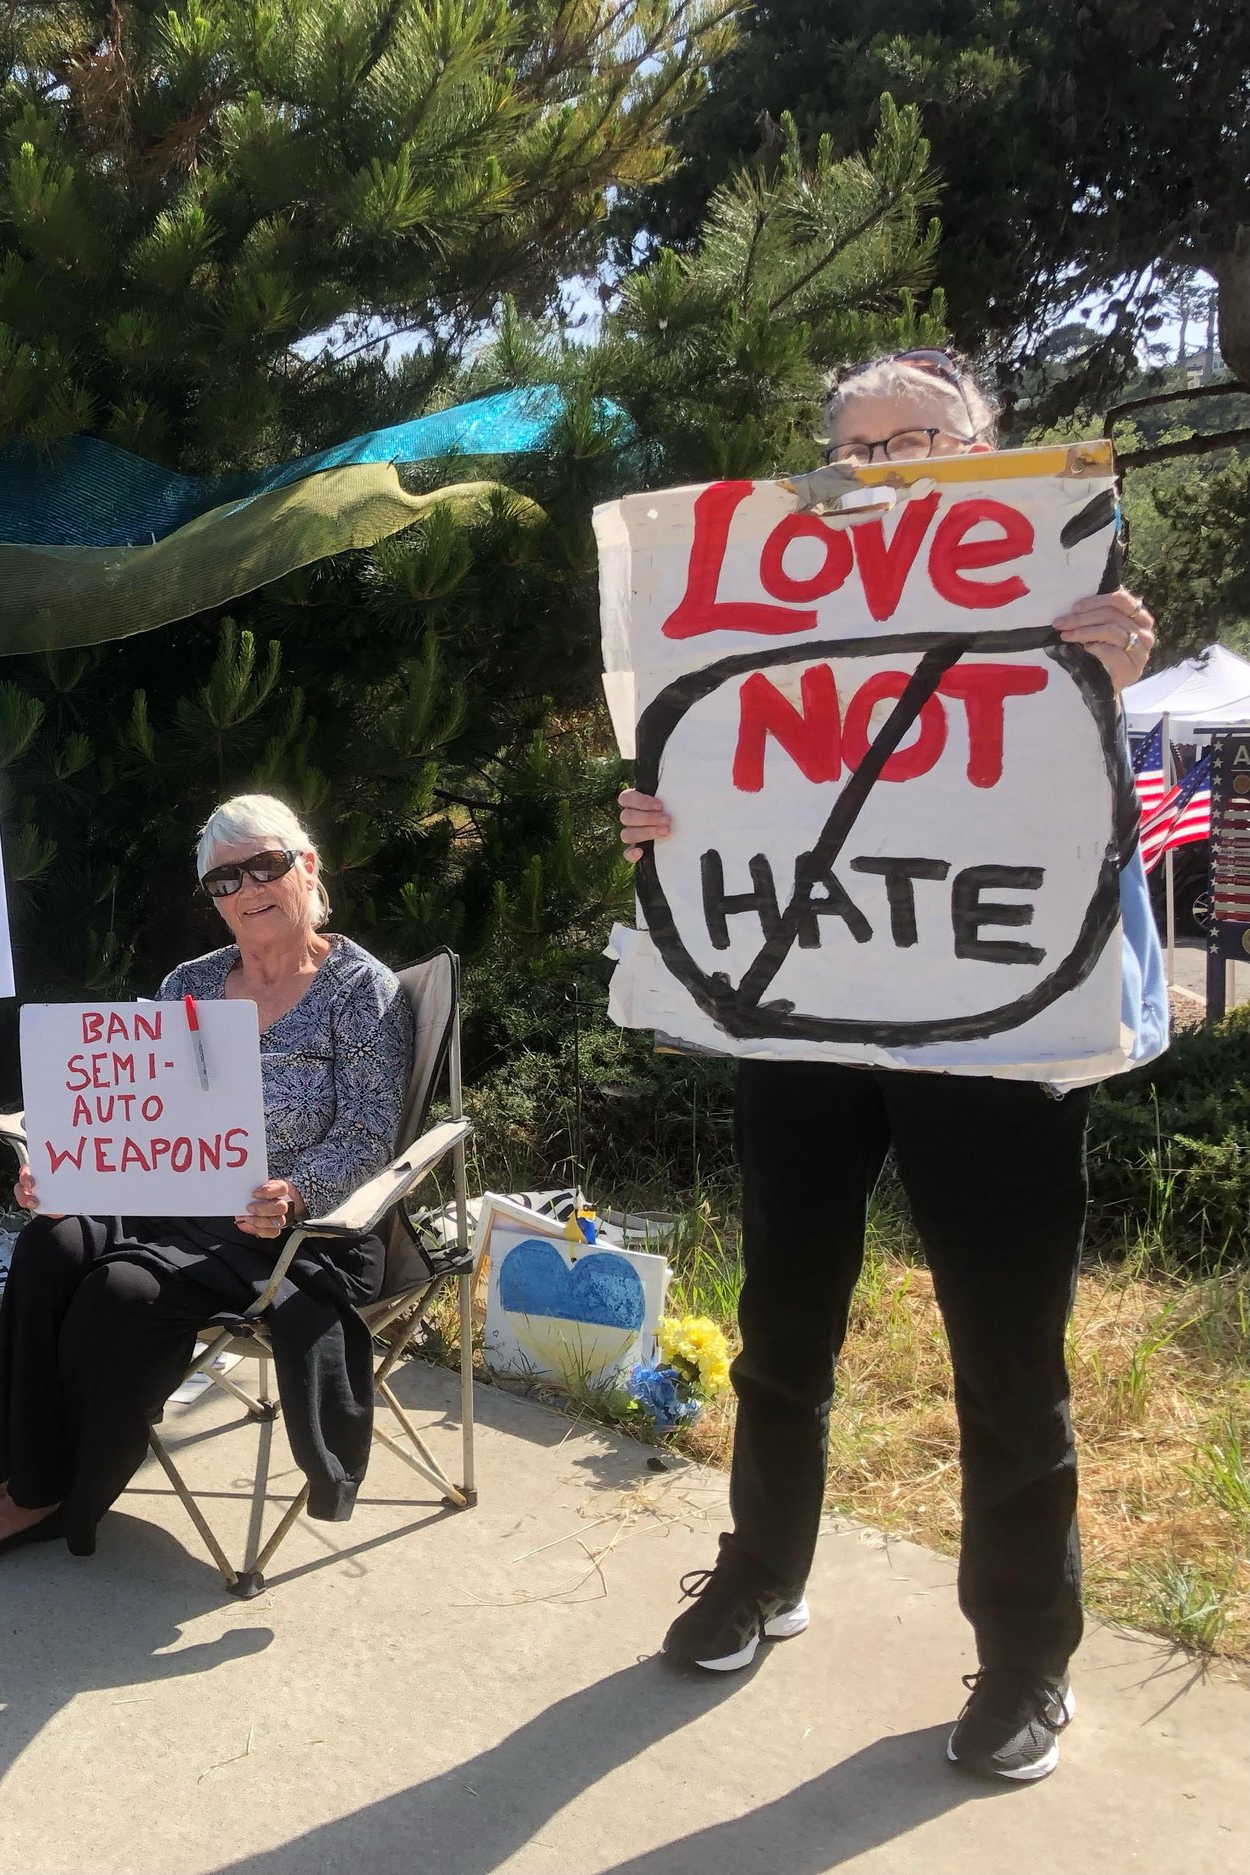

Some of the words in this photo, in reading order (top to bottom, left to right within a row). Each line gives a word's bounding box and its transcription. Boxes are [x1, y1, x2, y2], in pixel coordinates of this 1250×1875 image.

[732, 663, 1050, 794] NOT
[699, 848, 1048, 966] HATE
[81, 1010, 162, 1044] BAN
[65, 1051, 174, 1092] SEMI-
[72, 1094, 164, 1127] AUTO
[45, 1128, 249, 1175] WEAPONS
